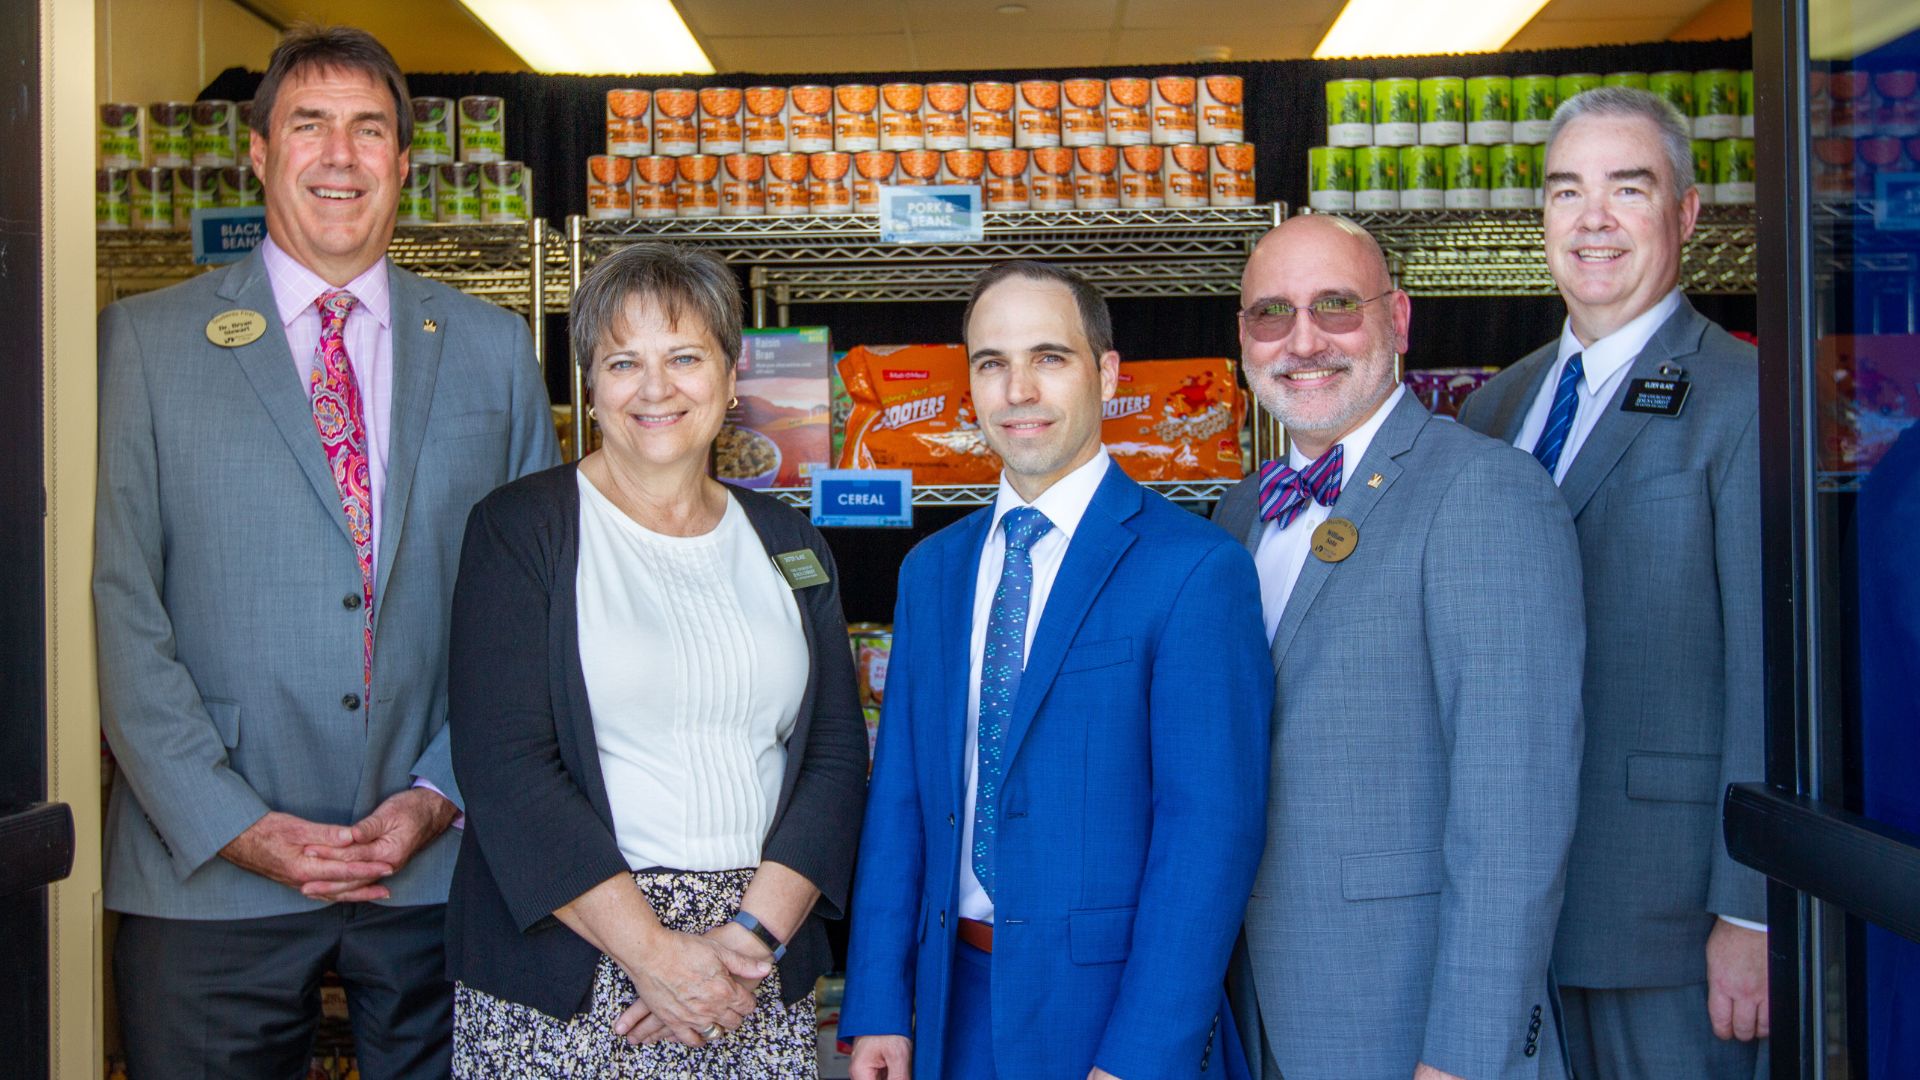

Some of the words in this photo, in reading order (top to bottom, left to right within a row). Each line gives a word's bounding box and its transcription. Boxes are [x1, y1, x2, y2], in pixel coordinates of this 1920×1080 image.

[907, 202, 942, 214] PORK
[945, 202, 954, 213] &
[911, 215, 952, 227] BEANS
[221, 223, 261, 236] BLACK
[754, 336, 781, 348] Raisin
[754, 349, 775, 361] Bran
[837, 493, 885, 506] CEREAL
